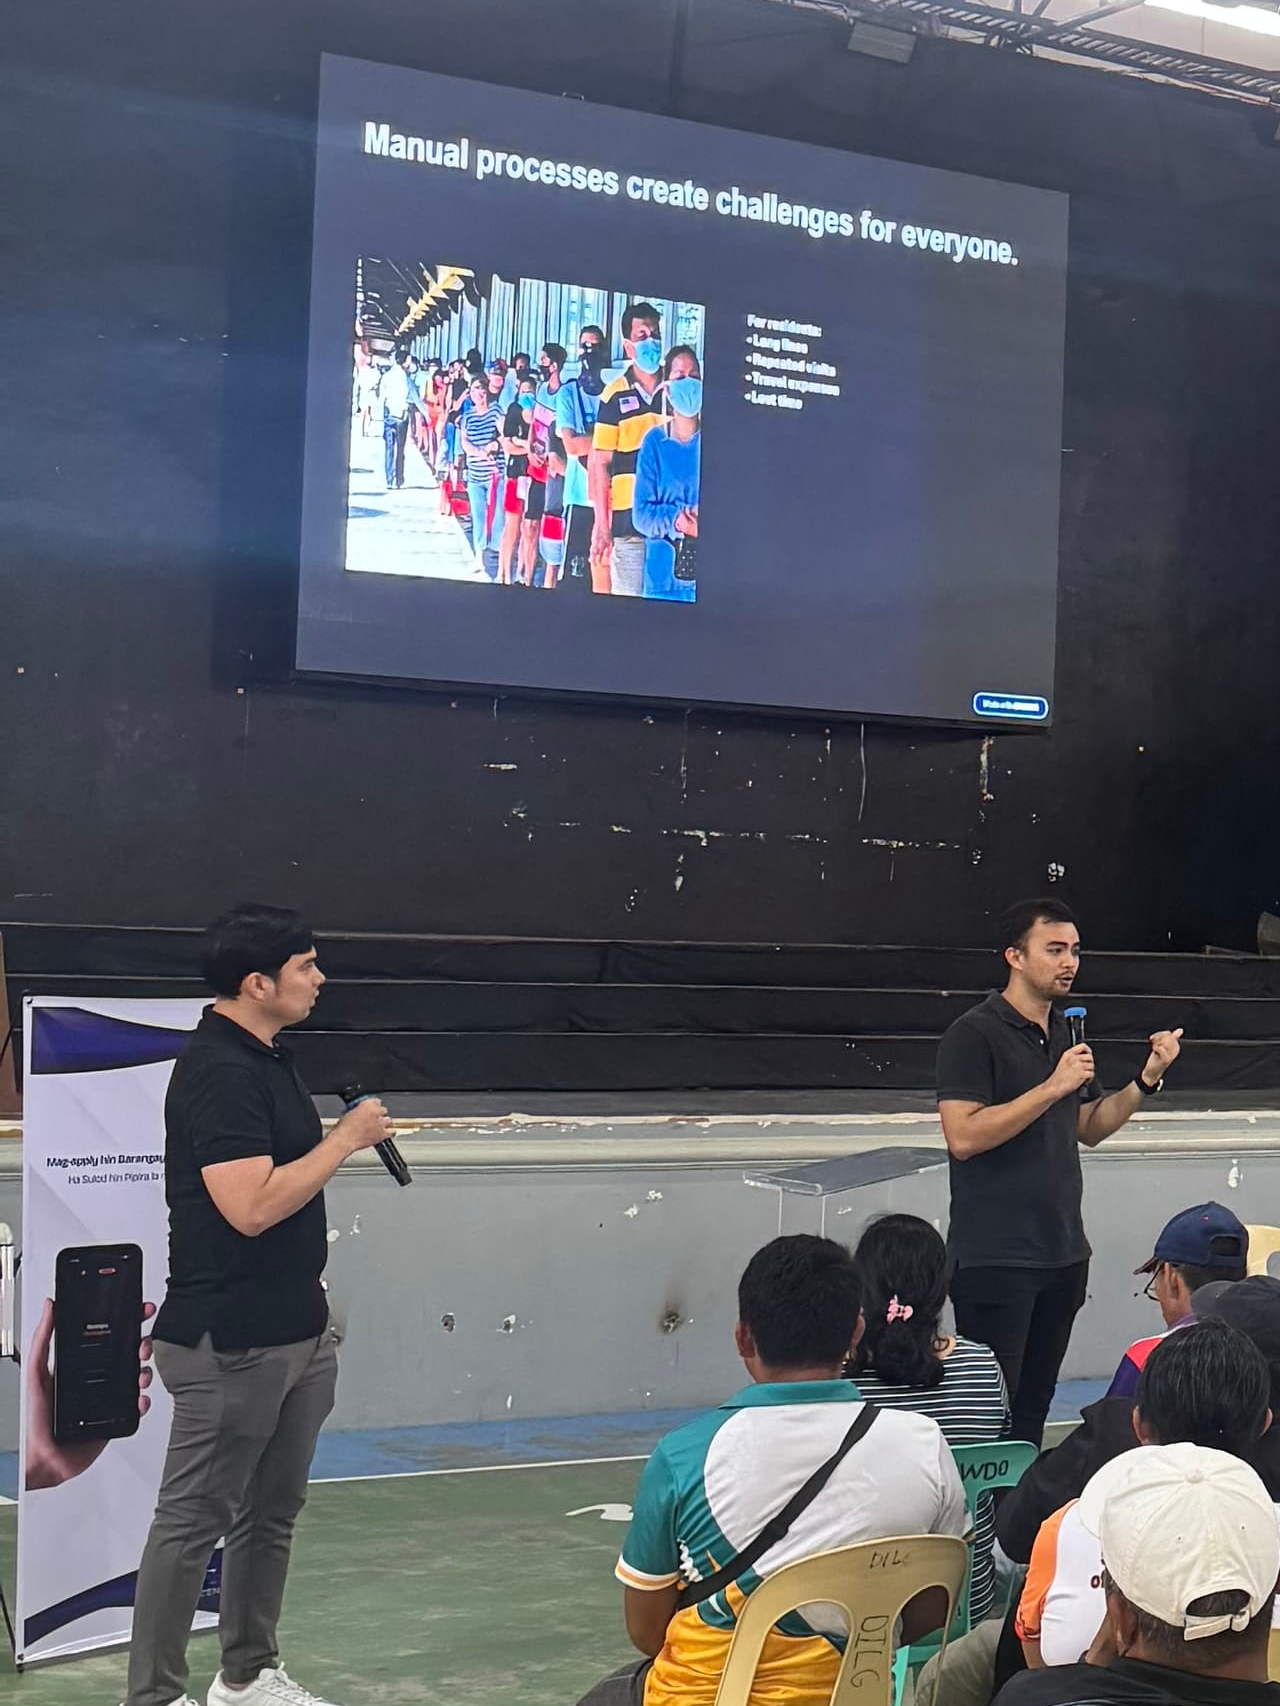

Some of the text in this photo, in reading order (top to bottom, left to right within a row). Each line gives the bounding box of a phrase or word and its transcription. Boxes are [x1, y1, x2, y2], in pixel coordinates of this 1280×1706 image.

[364, 121, 1018, 266] Manual processes create challenges for everyone.
[960, 1460, 1008, 1481] WDO
[851, 1615, 889, 1688] DILG
